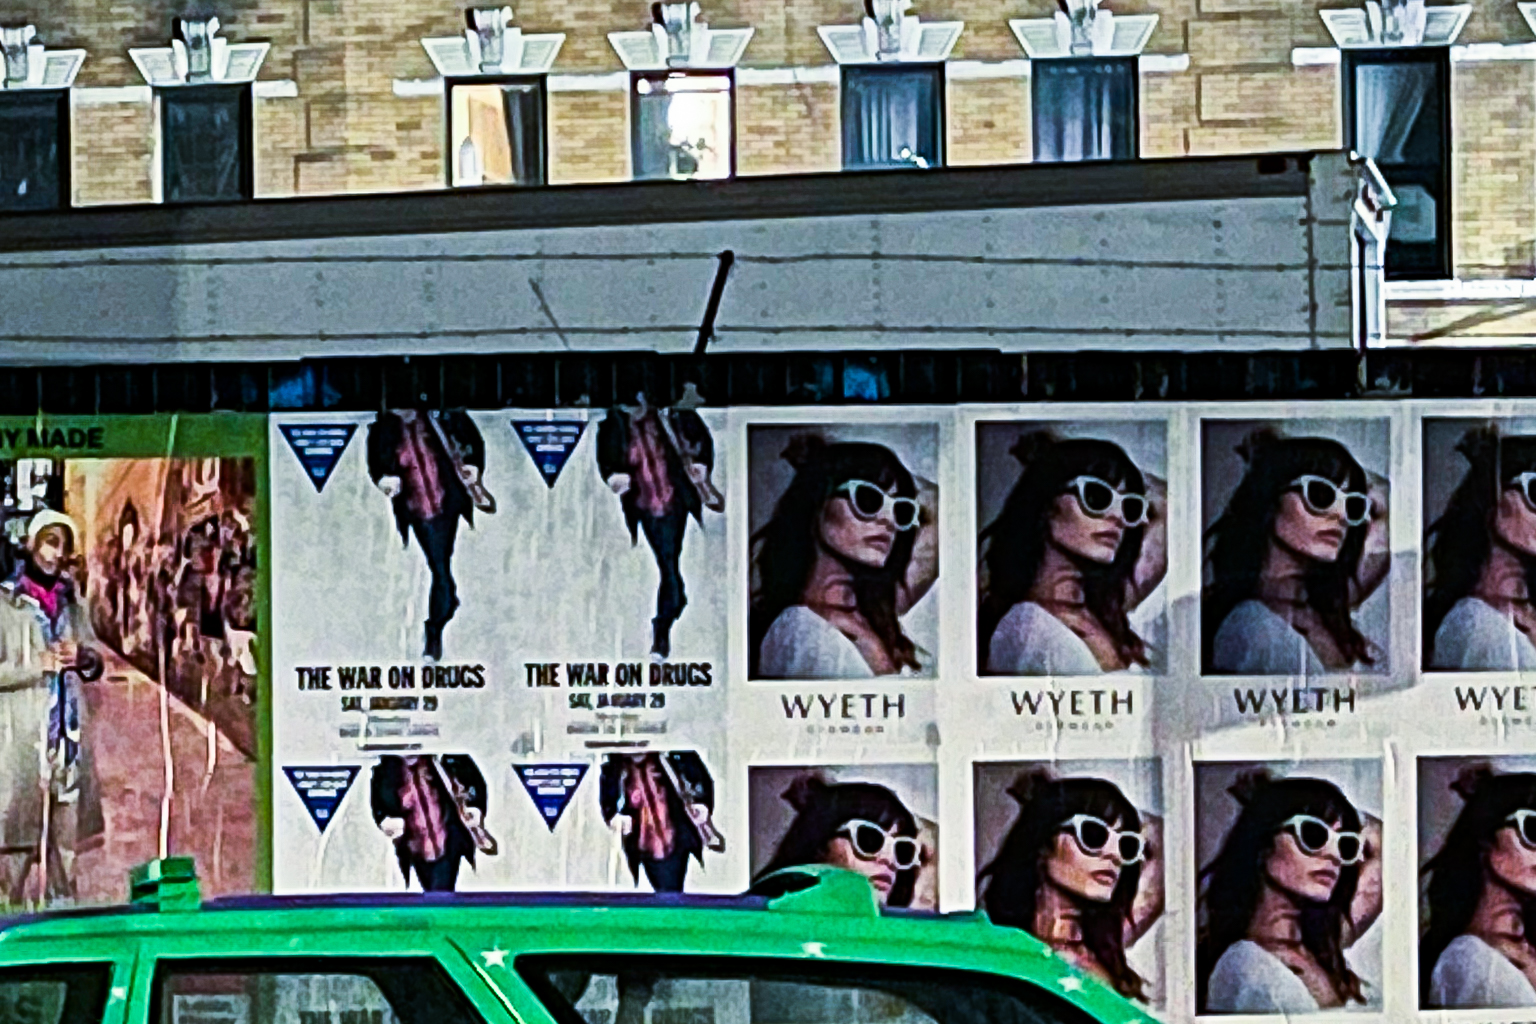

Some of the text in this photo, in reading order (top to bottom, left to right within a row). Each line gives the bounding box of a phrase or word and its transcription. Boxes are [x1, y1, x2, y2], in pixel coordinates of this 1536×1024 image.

[26, 427, 104, 449] MADE
[296, 663, 486, 690] THE WAR ON DRUGS
[524, 662, 713, 687] THE WAR ON DRUGS
[781, 693, 906, 718] WYETH
[1011, 689, 1133, 715] WYETH
[1234, 687, 1356, 713] WYETH
[1454, 686, 1536, 710] WYE
